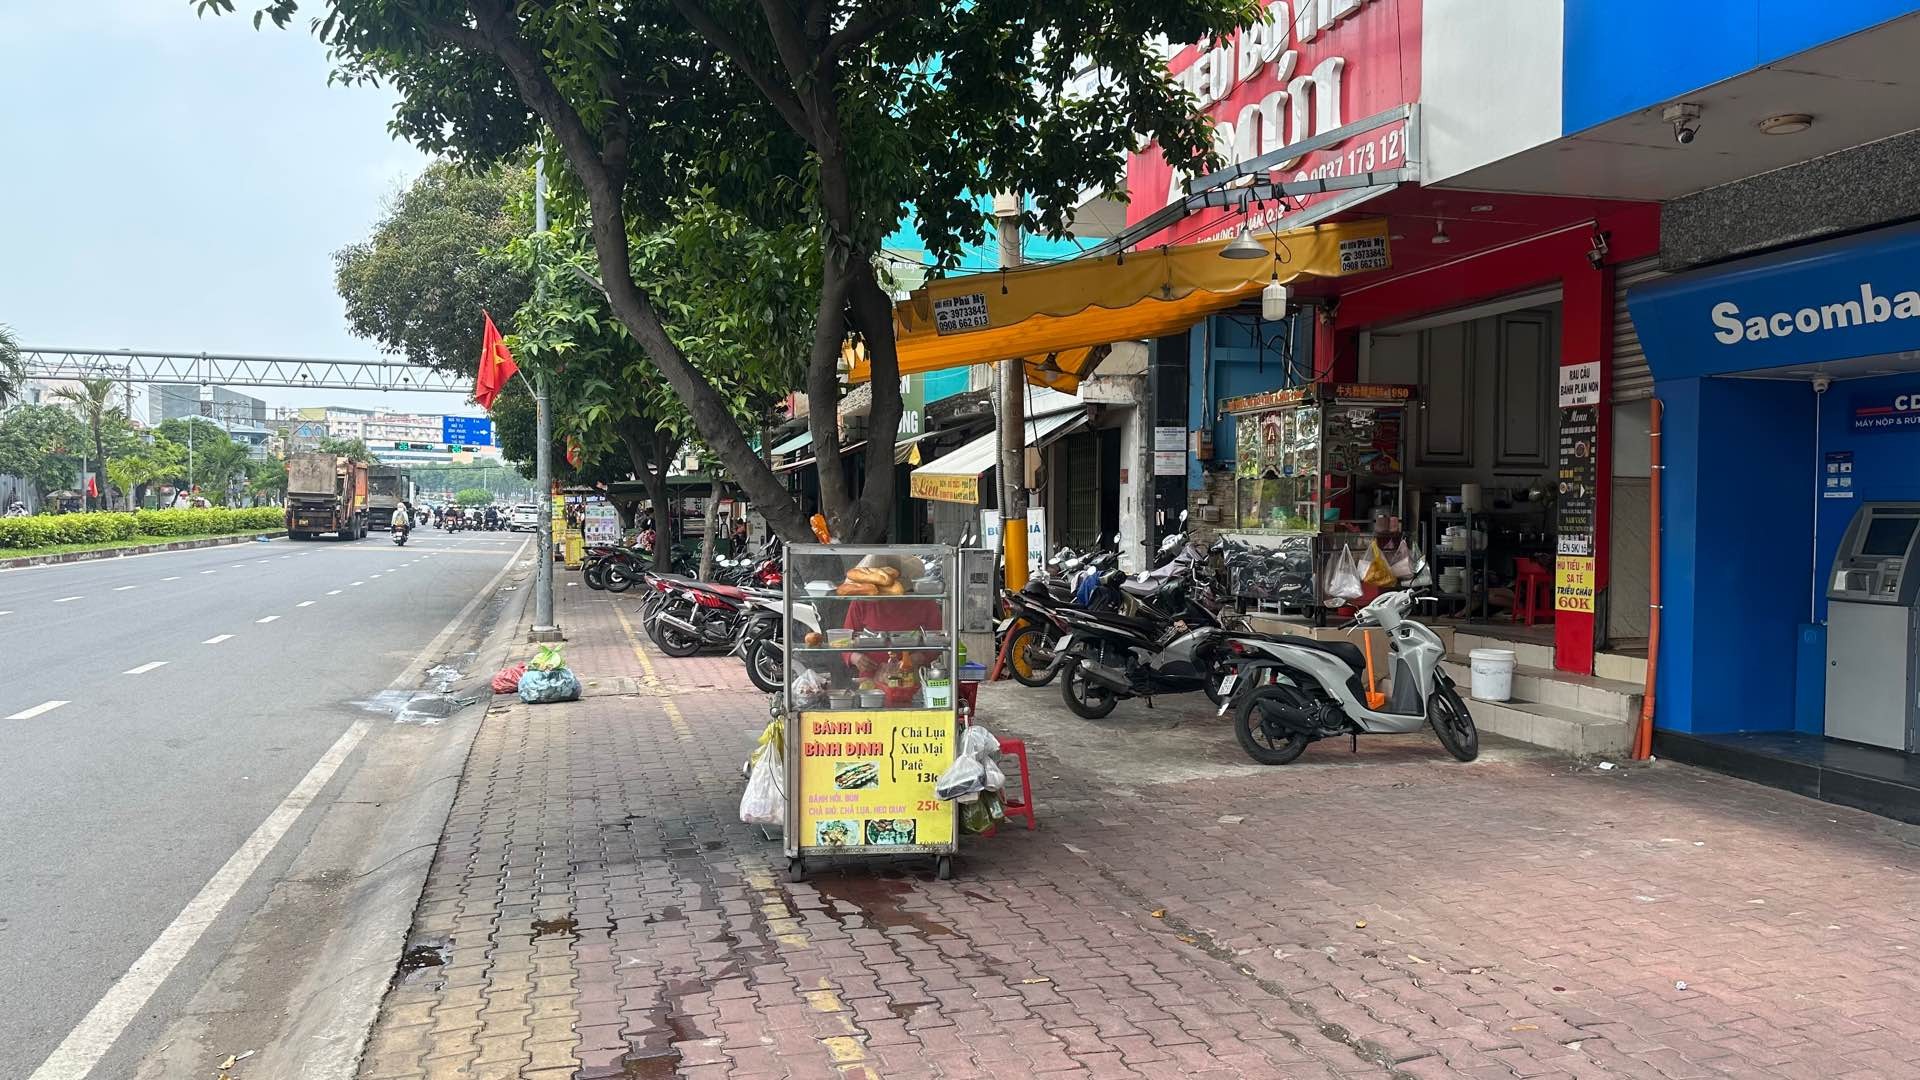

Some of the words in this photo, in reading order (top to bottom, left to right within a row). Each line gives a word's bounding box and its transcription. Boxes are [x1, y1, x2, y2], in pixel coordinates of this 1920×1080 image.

[1348, 141, 1376, 176] 173
[1354, 248, 1386, 260] 39733842
[1342, 261, 1359, 271] 0908
[950, 305, 986, 319] 39733842
[1711, 283, 1920, 345] Sacomba
[939, 320, 958, 331] 0908
[959, 318, 973, 328] 662
[974, 315, 988, 326] 613
[1856, 418, 1874, 428] MÁY
[1876, 417, 1895, 427] NỘP
[1567, 573, 1574, 583] SA
[1558, 596, 1590, 609] 60K
[813, 719, 852, 734] BÁNH
[926, 726, 946, 740] Lụa
[804, 740, 842, 756] BÌNH
[846, 742, 884, 759] ĐỊNH
[901, 743, 919, 754] Xíu
[922, 743, 943, 756] Mại
[901, 759, 924, 771] Patê
[917, 772, 938, 783] 13k
[917, 800, 940, 811] 25k
